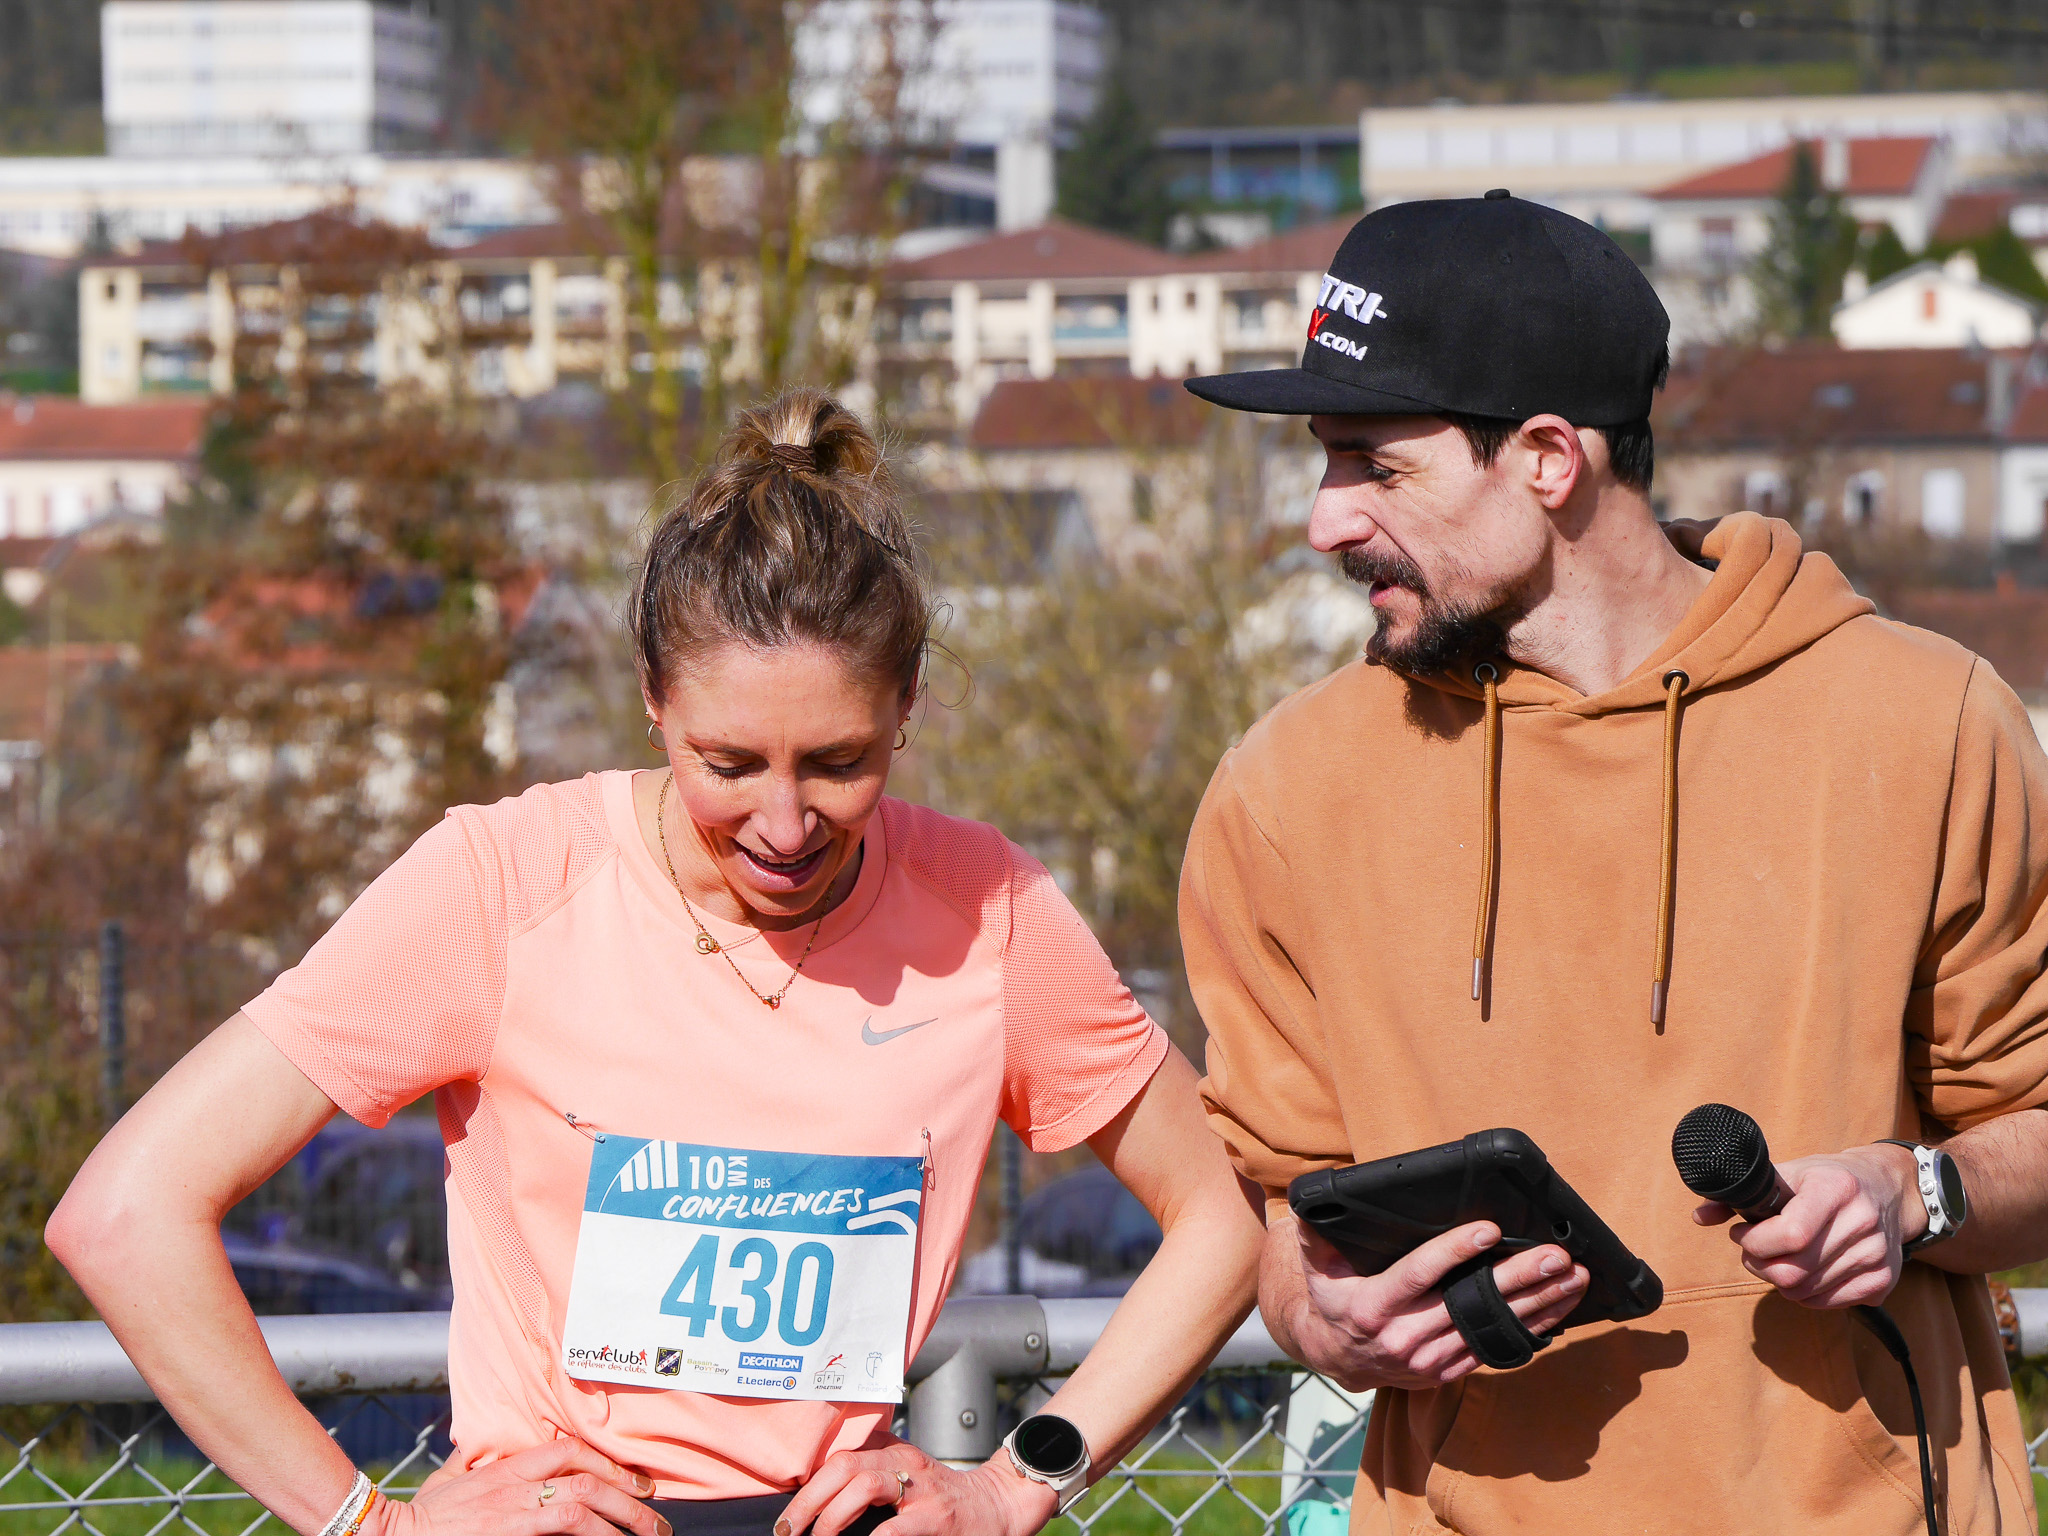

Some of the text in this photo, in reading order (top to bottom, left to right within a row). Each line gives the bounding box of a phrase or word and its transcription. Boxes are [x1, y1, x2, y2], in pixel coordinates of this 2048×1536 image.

[689, 1155, 748, 1190] 10 KM
[754, 1177, 771, 1189] DES
[662, 1187, 865, 1221] CONFLUENCES
[659, 1233, 835, 1347] 430
[567, 1358, 576, 1366] le
[608, 1362, 622, 1371] des
[687, 1358, 713, 1367] Bassin
[742, 1355, 800, 1369] DECATHLON
[737, 1376, 782, 1387] E.Leclerc
